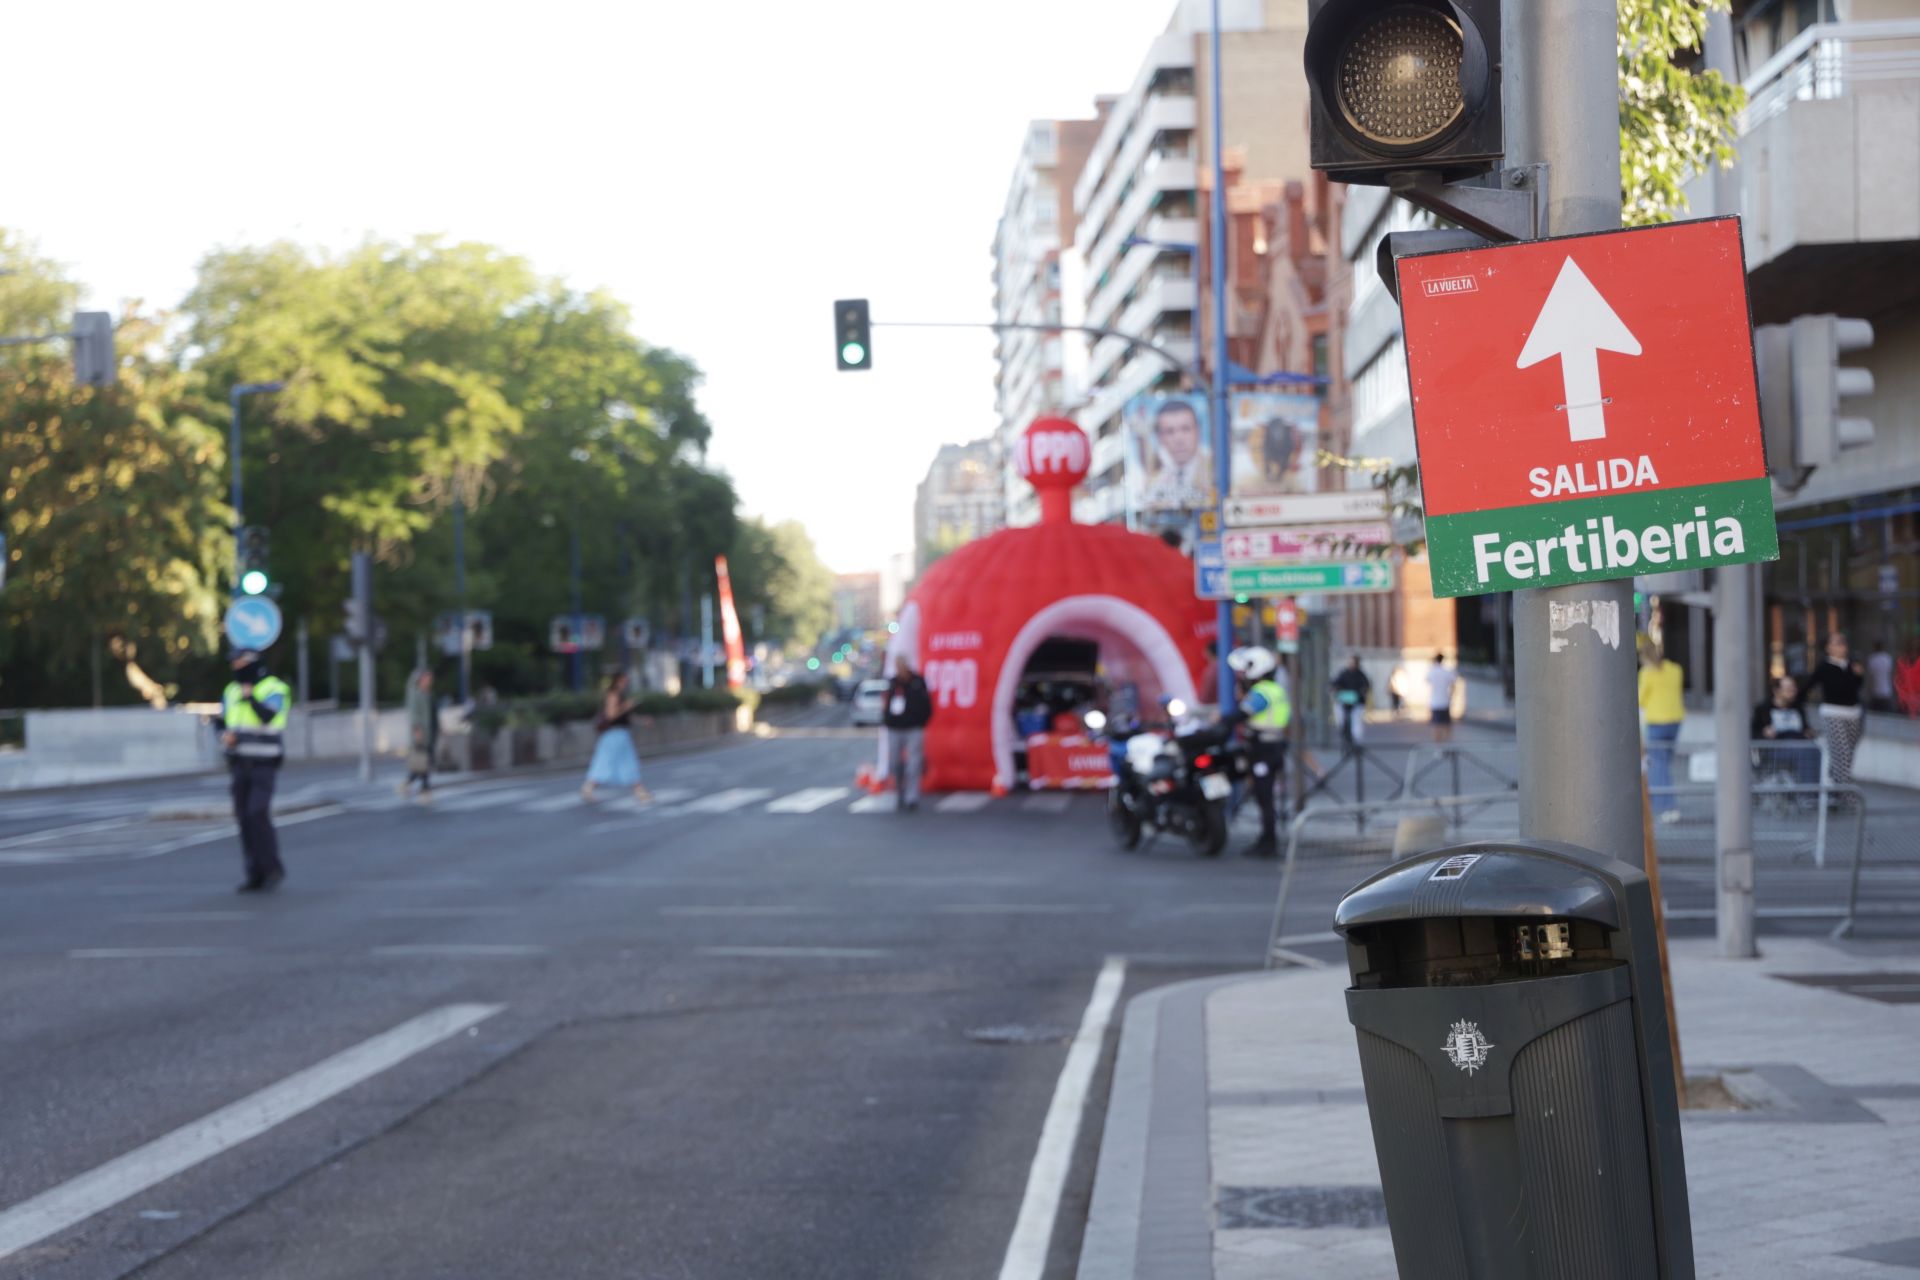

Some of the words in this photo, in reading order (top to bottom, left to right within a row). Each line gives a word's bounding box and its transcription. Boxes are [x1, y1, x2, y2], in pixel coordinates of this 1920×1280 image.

[1427, 282, 1440, 294] LA
[1439, 278, 1473, 292] VUELTA
[1528, 455, 1659, 498] SALIDA
[1473, 506, 1745, 583] Fertiberia
